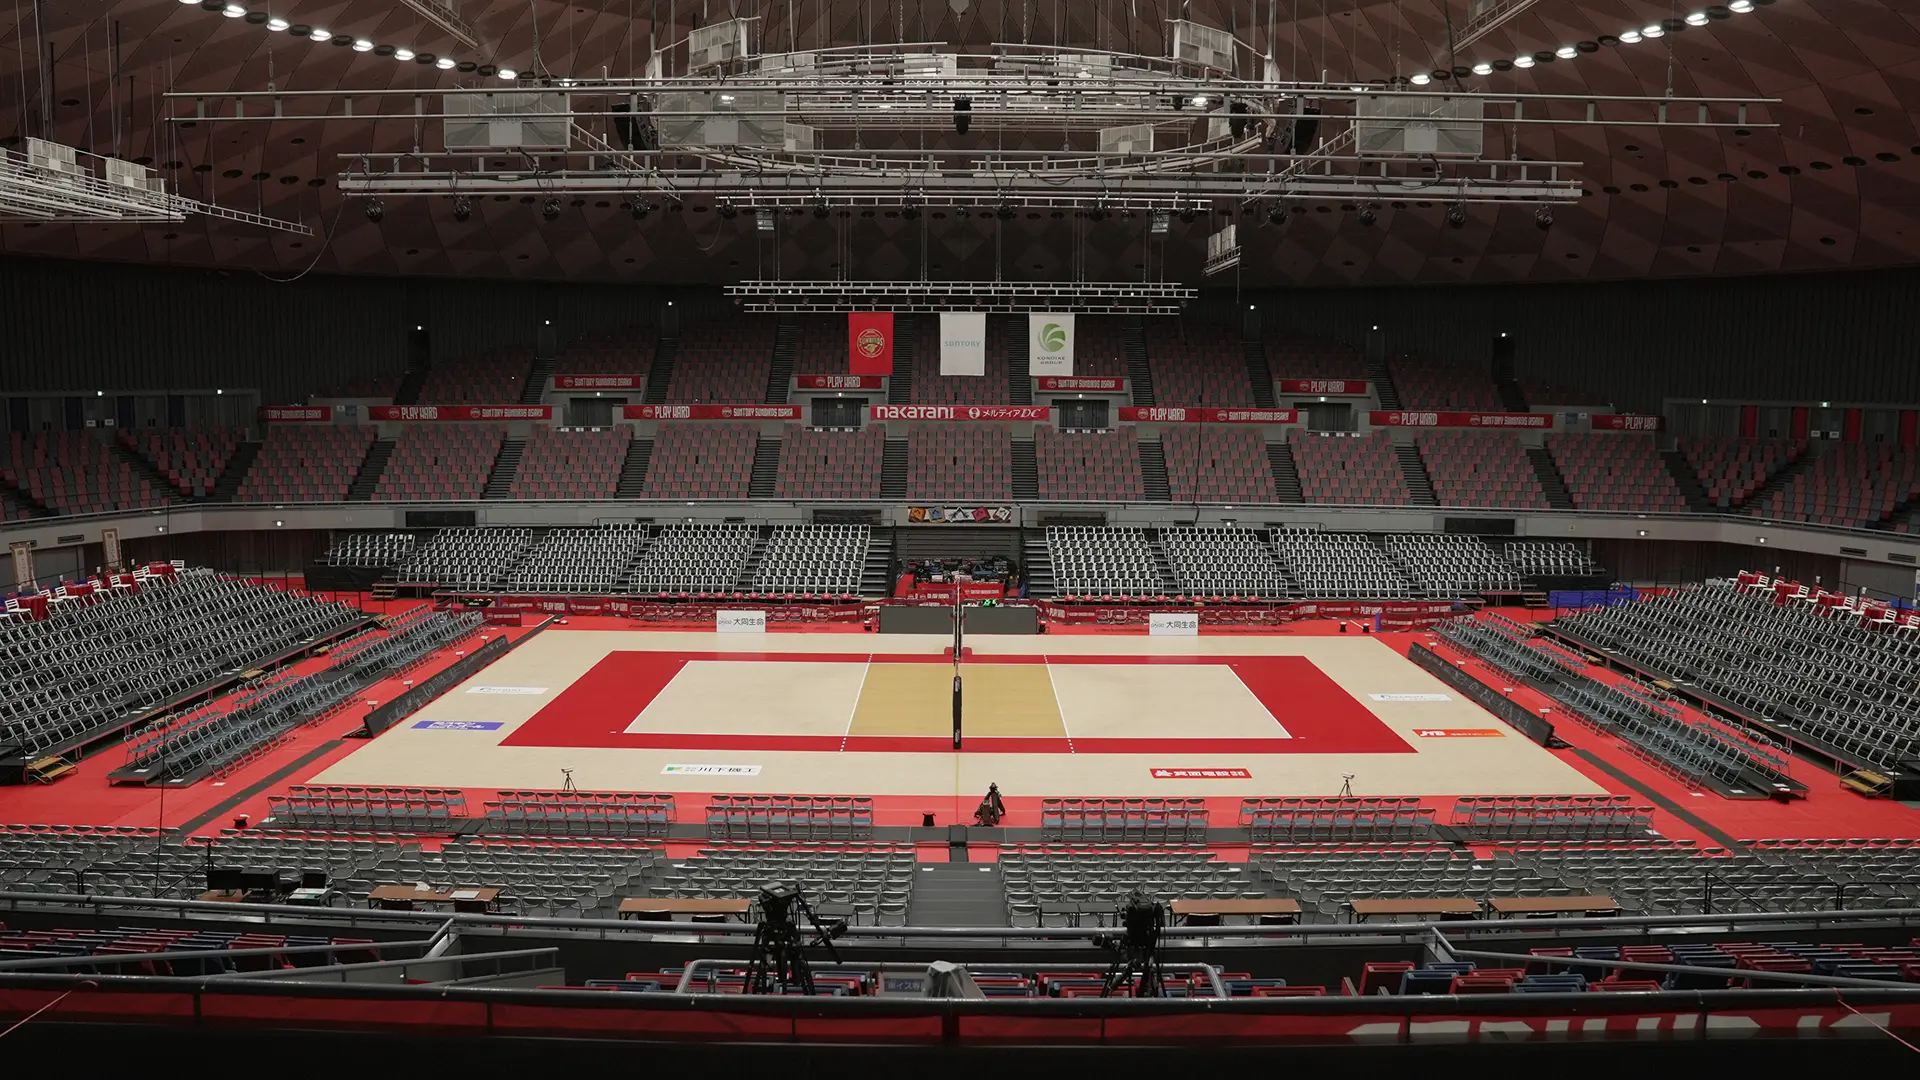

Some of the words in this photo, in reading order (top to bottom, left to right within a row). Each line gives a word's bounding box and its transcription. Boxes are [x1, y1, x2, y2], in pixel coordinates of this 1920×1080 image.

[827, 376, 843, 388] PLAY
[1311, 381, 1327, 392] PLAY
[401, 407, 418, 419] PLAY
[655, 406, 672, 419] PLAY
[673, 406, 690, 419] HARD
[1150, 408, 1167, 420] PLAY
[1168, 408, 1184, 420] HARD
[1401, 413, 1418, 425] PLAY
[733, 618, 764, 626] 大同生命
[1166, 621, 1197, 629] 大同生命
